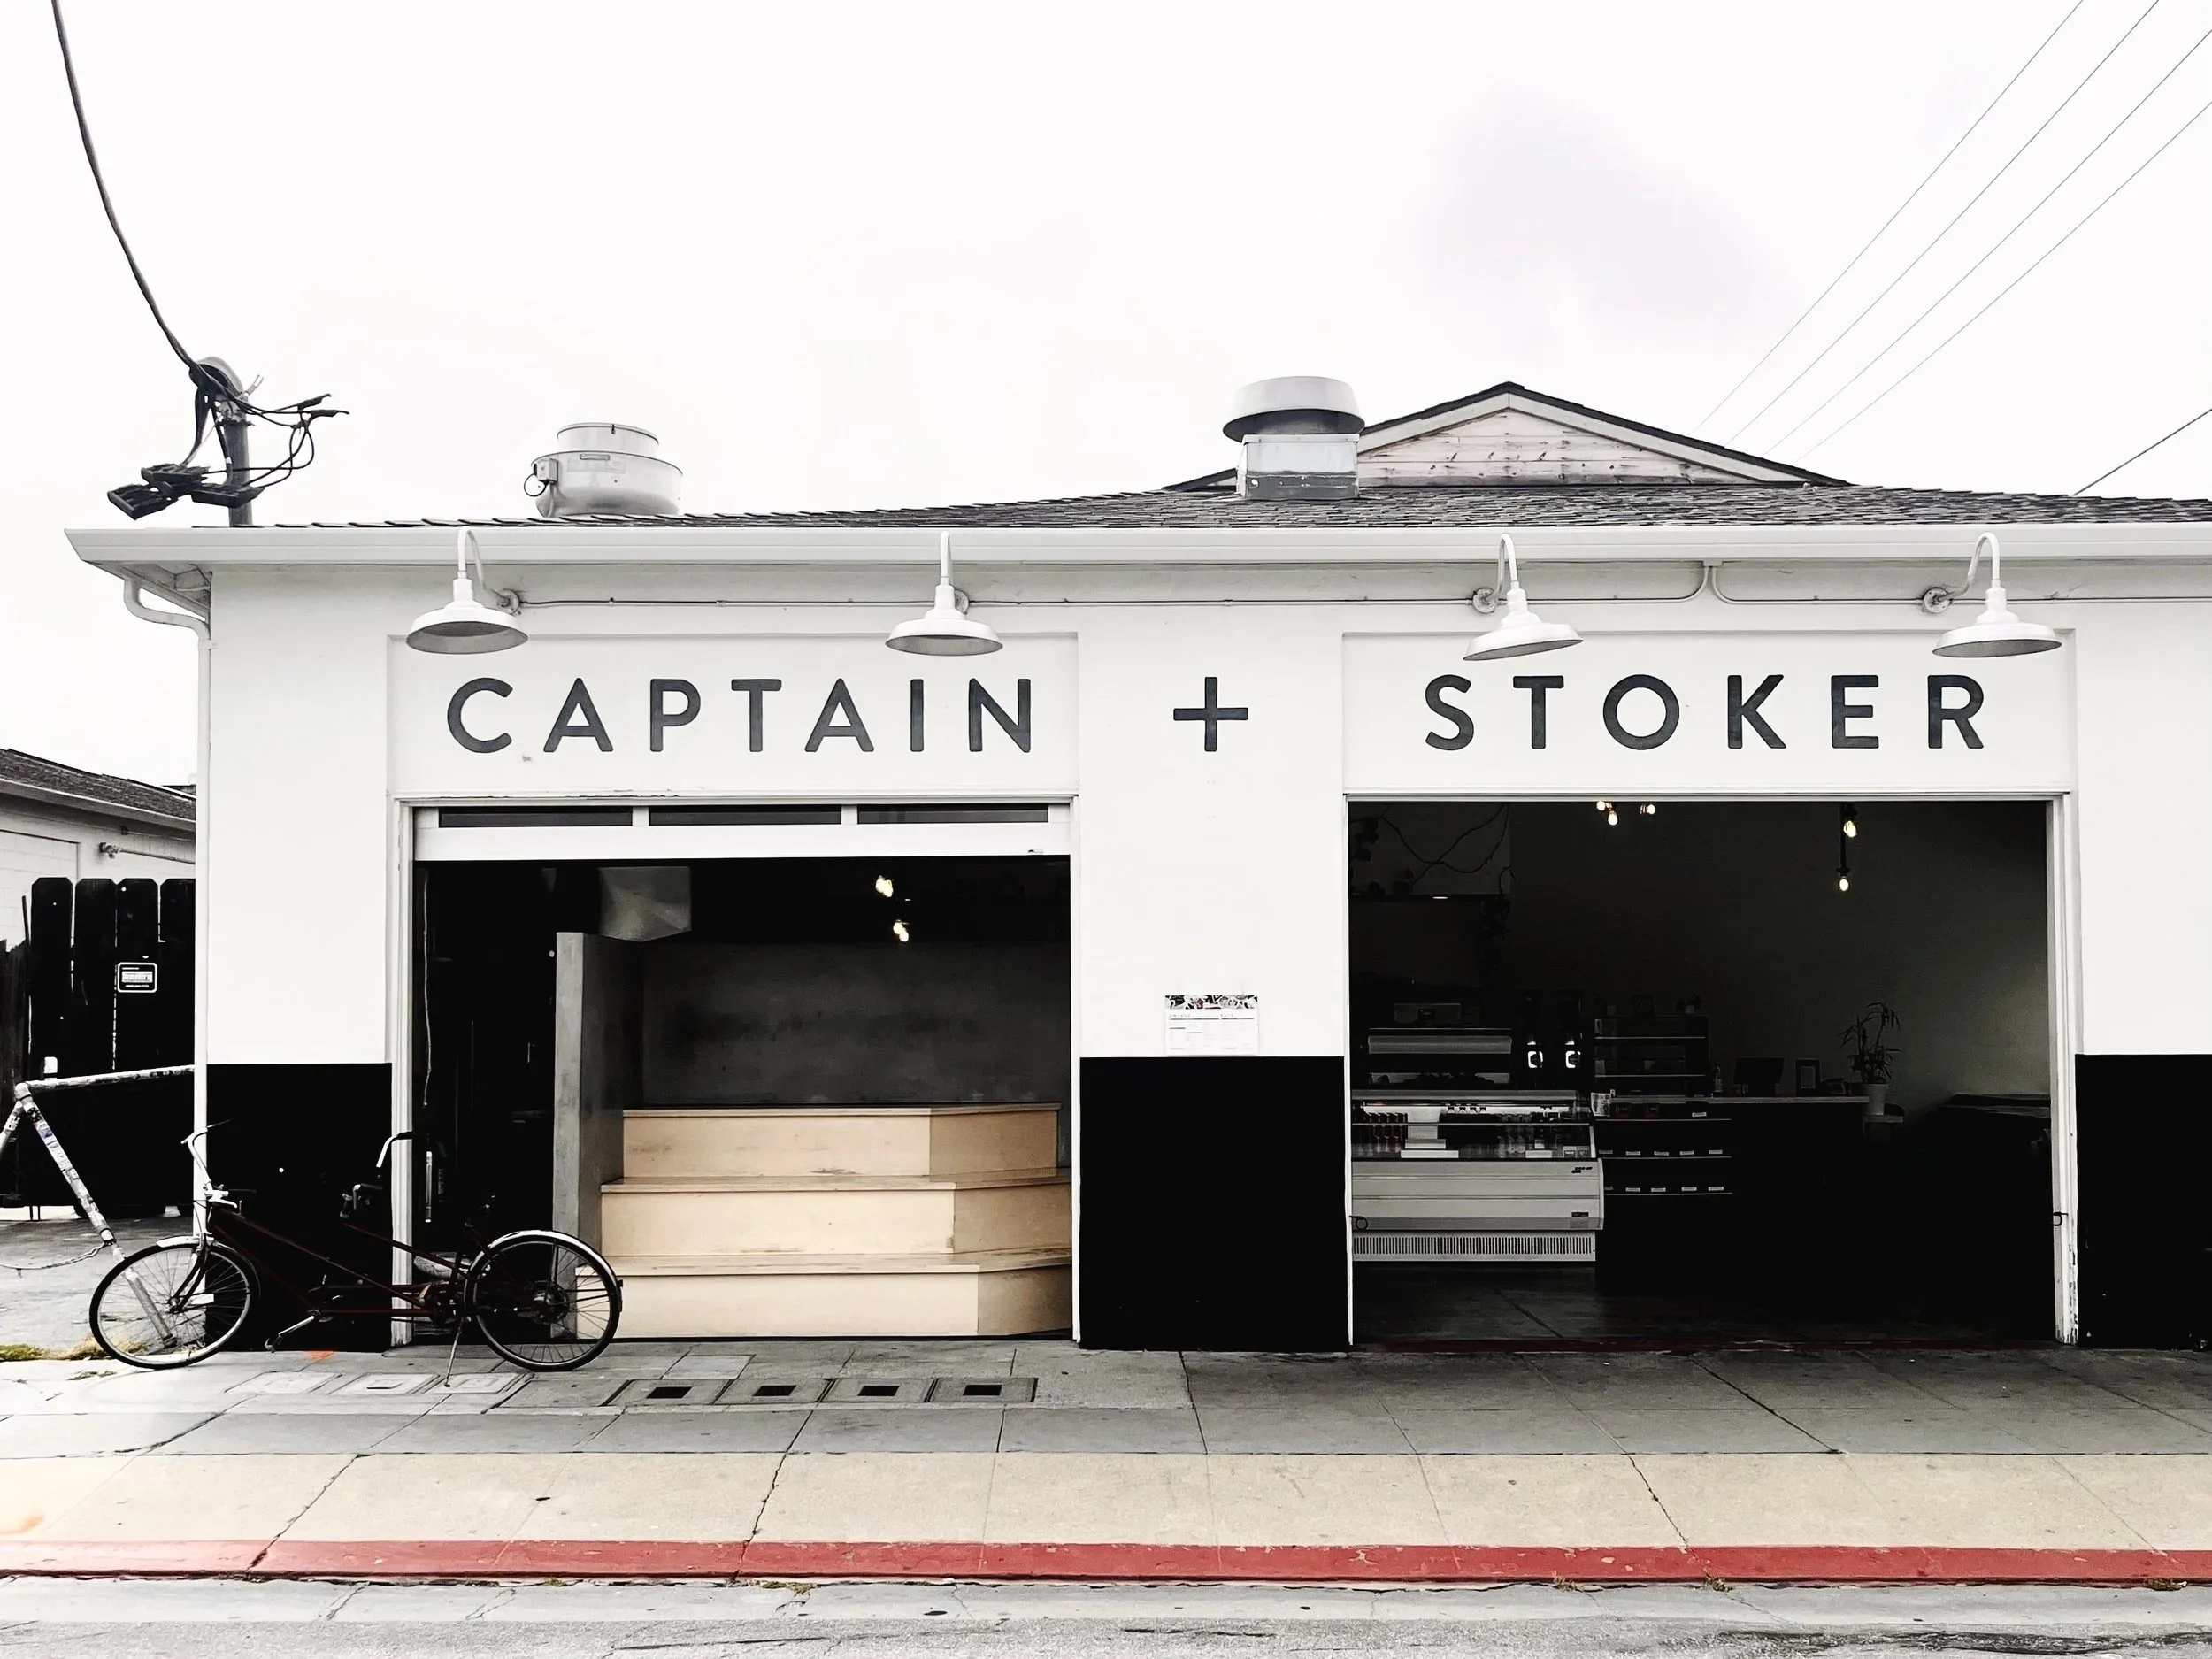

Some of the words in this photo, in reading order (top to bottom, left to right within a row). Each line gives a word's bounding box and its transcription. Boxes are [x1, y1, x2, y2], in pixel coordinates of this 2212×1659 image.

[447, 677, 1032, 754] CAPTAIN
[1172, 676, 1249, 753] +
[1425, 673, 1985, 751] STOKER
